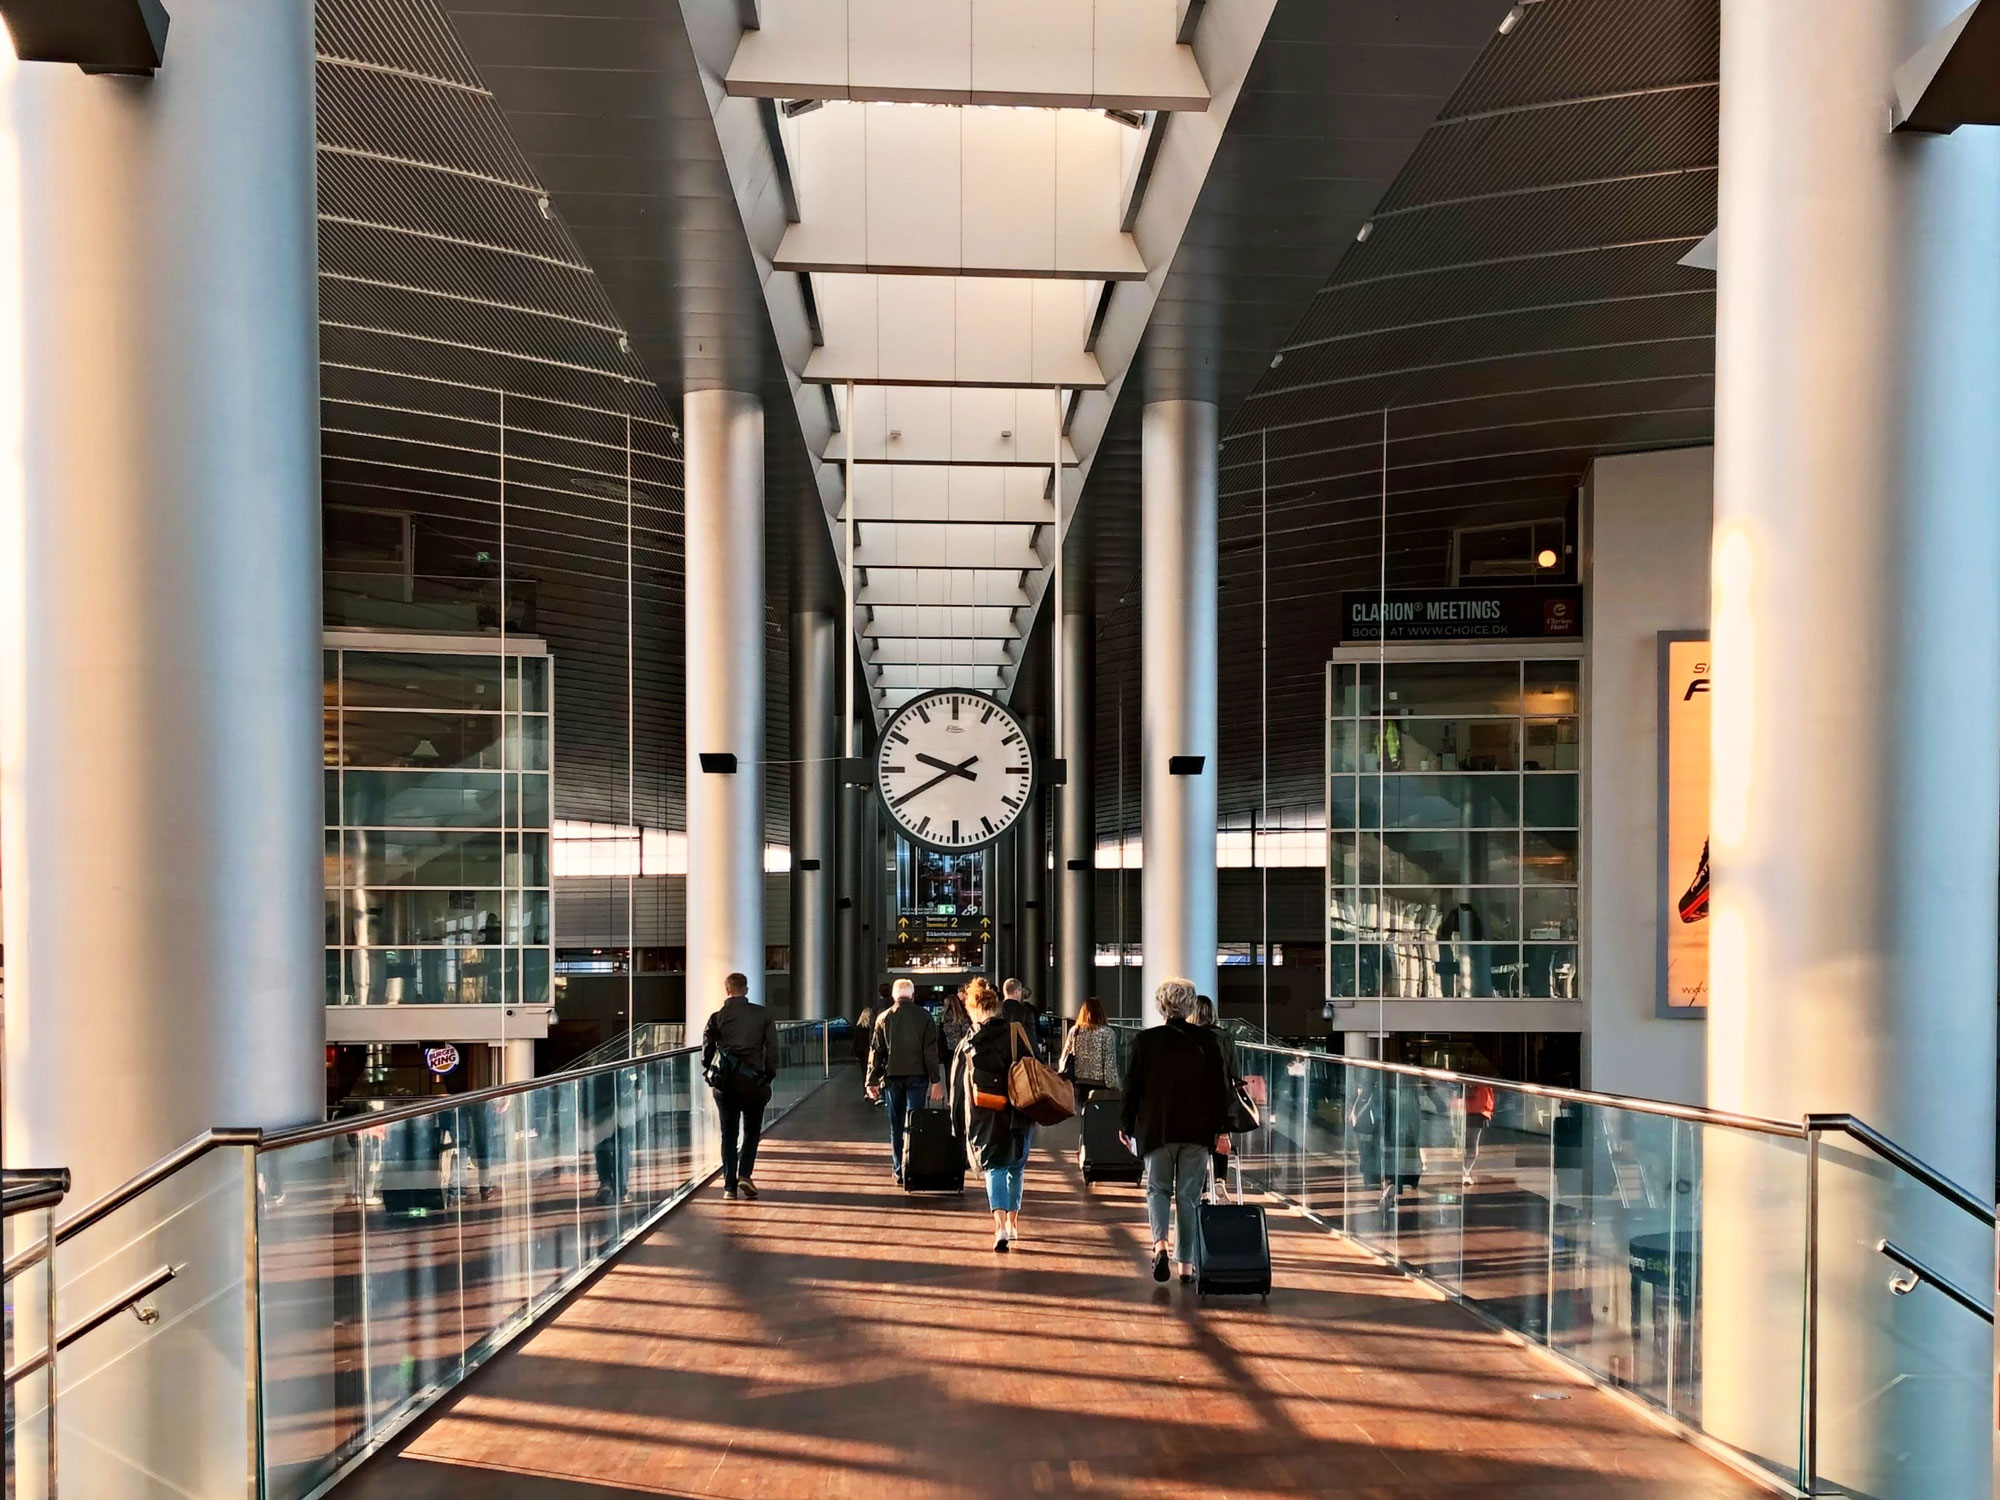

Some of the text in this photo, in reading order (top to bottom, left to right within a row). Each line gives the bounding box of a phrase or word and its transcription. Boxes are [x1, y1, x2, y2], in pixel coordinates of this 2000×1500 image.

[1427, 600, 1501, 620] MEETINGS
[1390, 627, 1405, 636] AT
[1408, 625, 1509, 636] WWW.CHOICE.DK
[951, 917, 958, 928] 2
[429, 1048, 455, 1059] BURGER
[430, 1053, 456, 1068] KING
